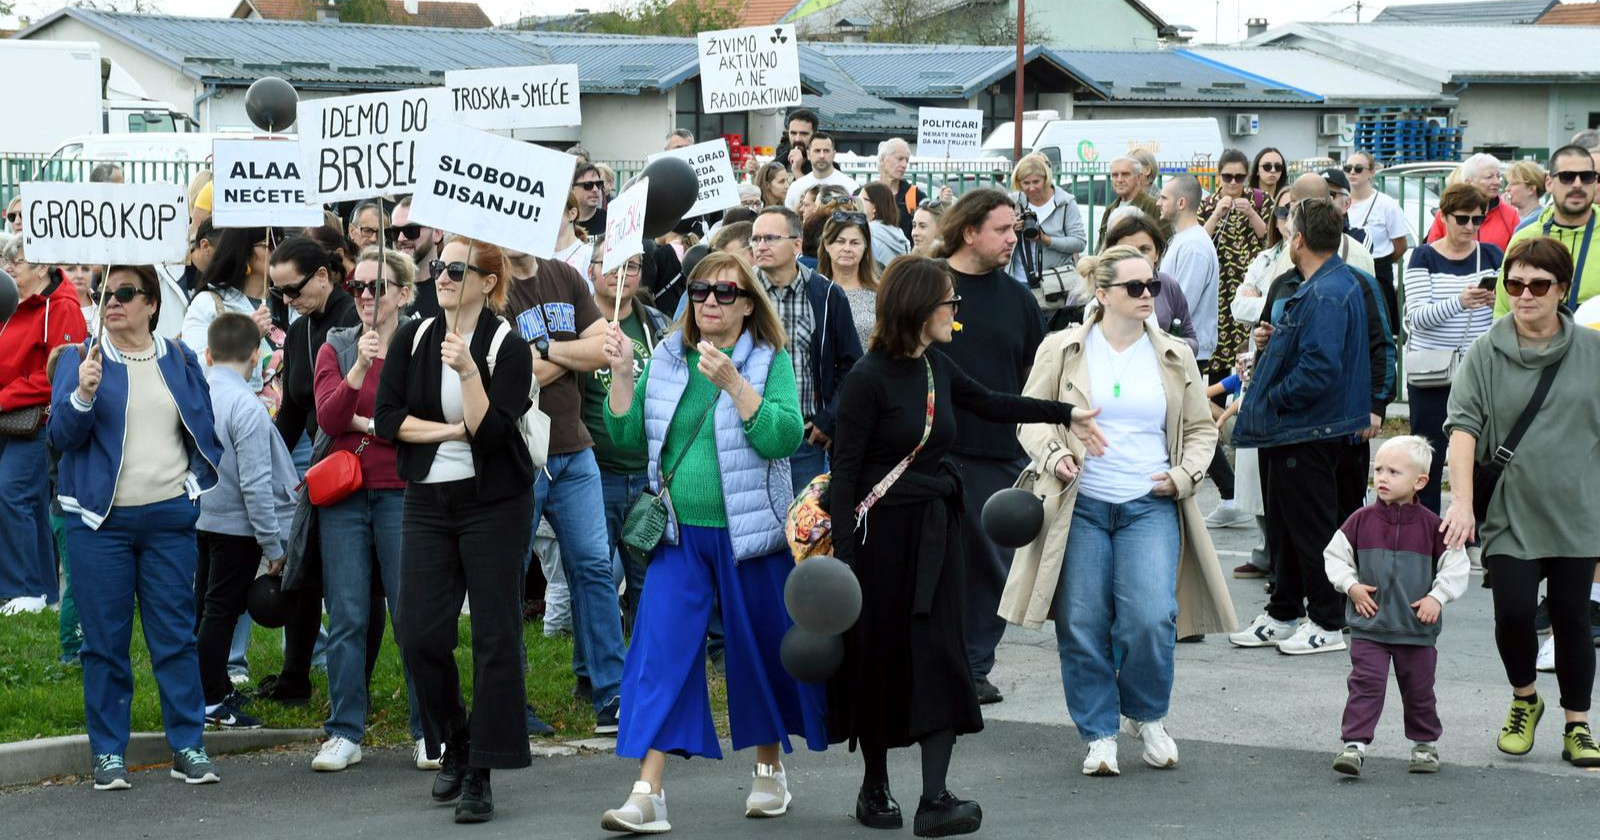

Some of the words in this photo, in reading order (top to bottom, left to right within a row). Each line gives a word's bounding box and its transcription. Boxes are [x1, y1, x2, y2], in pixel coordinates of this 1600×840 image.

[706, 35, 757, 55] ŽIVIMO
[719, 50, 778, 71] AKTIVNO
[735, 71, 744, 87] A
[750, 69, 767, 86] NE
[710, 85, 799, 109] RADIOAKTIVNO
[321, 102, 389, 139] IDEMO
[401, 97, 428, 132] DO
[922, 119, 978, 129] POLITIČARI
[318, 140, 417, 194] BRISEL
[697, 150, 725, 164] GRAD
[229, 161, 300, 180] ALAA
[438, 155, 545, 198] SLOBODA
[433, 179, 541, 222] DISANJU!
